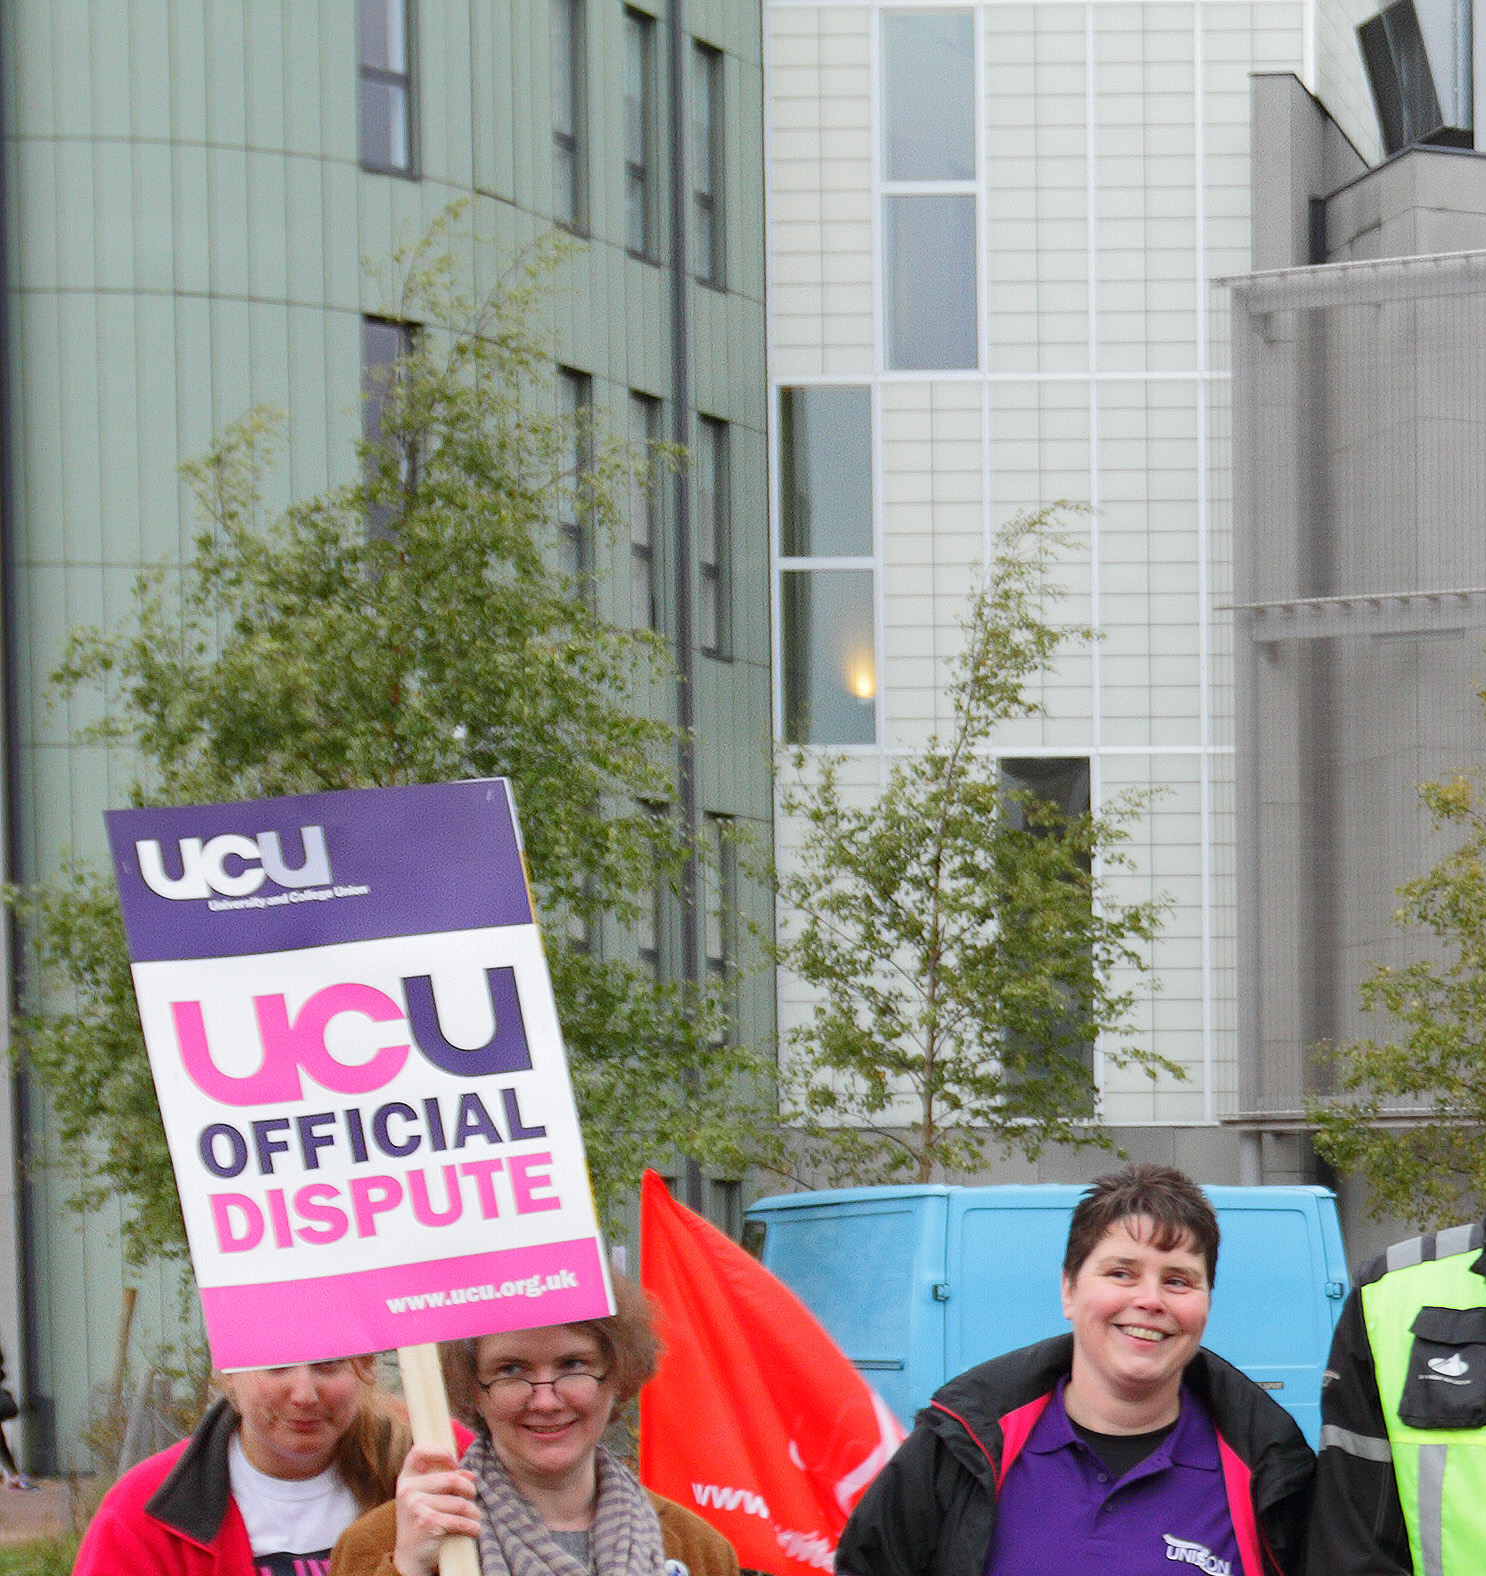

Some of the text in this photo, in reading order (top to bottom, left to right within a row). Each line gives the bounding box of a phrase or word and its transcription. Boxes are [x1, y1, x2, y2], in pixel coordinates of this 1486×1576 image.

[136, 825, 332, 900] UCU
[171, 966, 533, 1106] UCU
[199, 1088, 546, 1179] OFFICIAL
[208, 1152, 561, 1254] DISPUTE
[386, 1269, 577, 1314] www.ucu.org.uk
